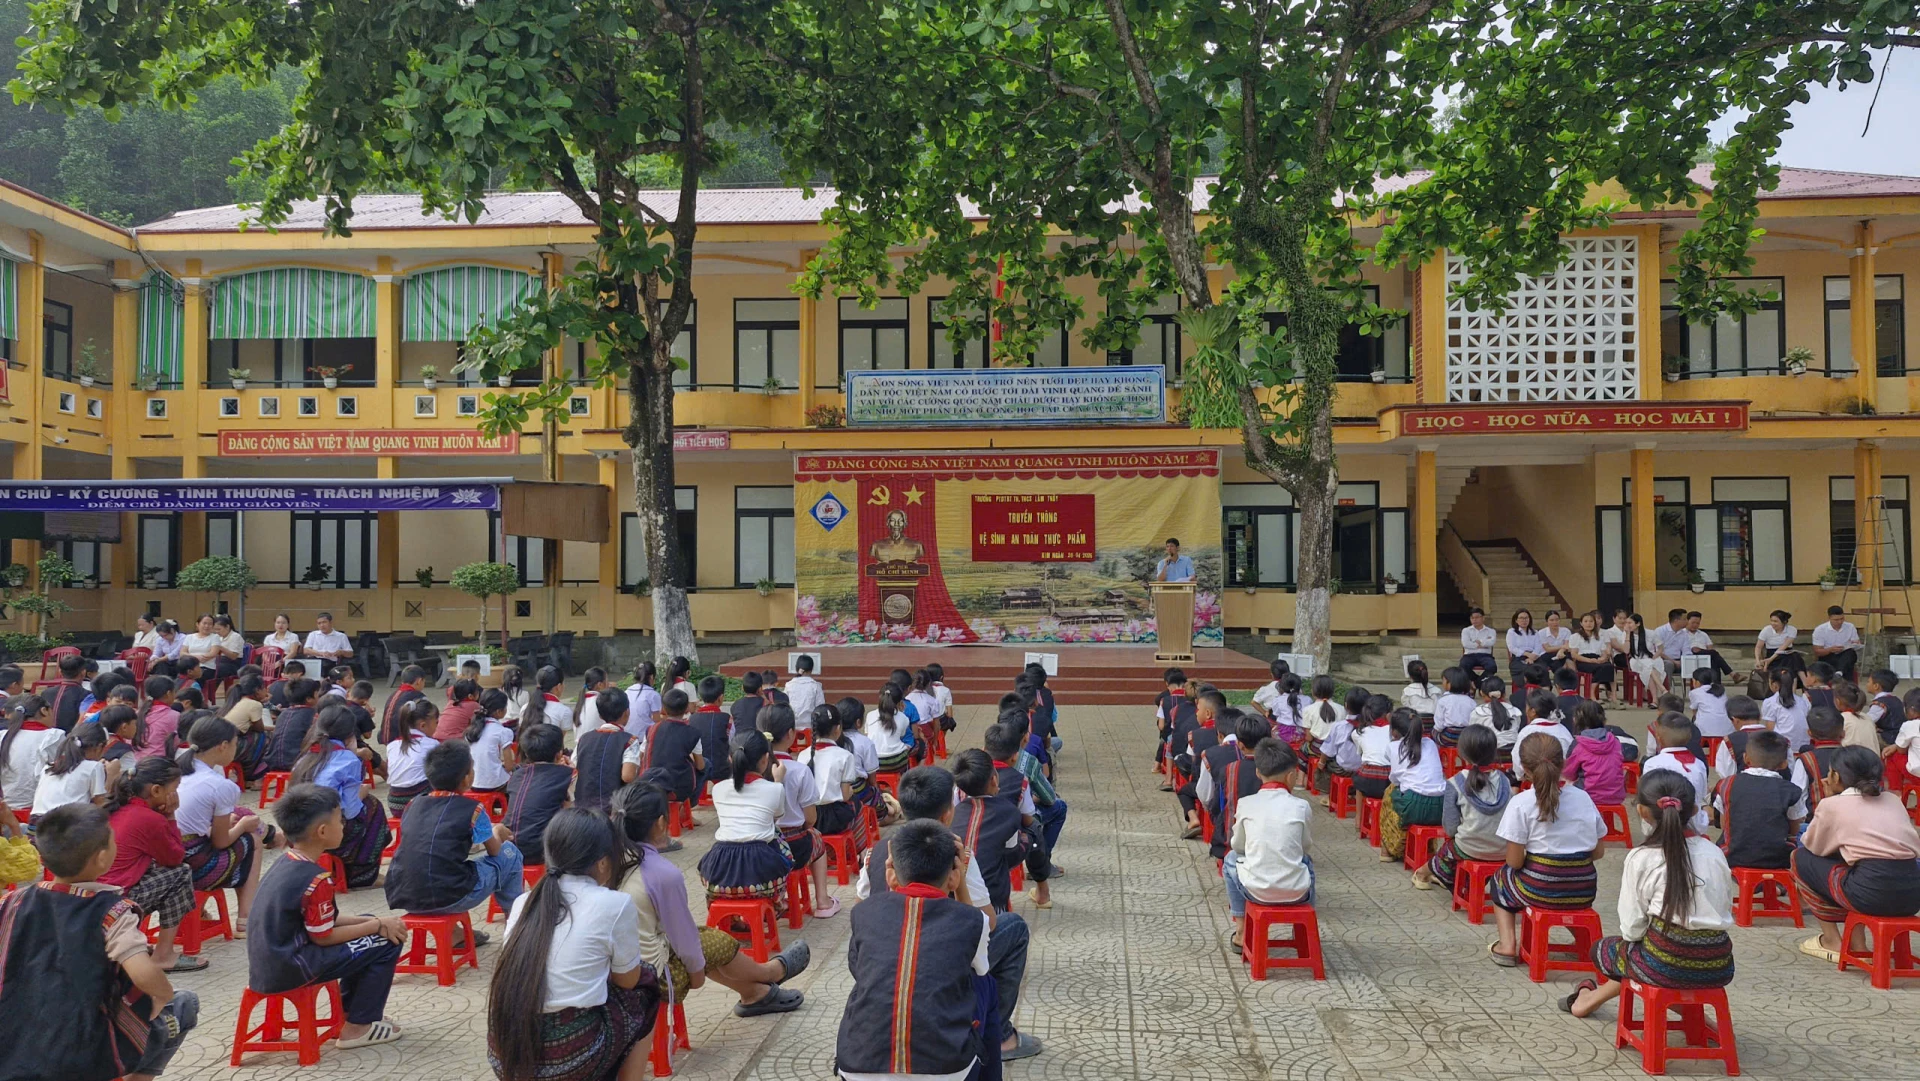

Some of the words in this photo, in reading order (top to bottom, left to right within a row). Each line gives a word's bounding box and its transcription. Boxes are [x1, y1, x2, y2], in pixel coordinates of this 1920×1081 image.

[1416, 416, 1464, 430] HỌC
[1488, 415, 1536, 428] HỌC
[1544, 411, 1592, 425] NỮA
[1614, 413, 1663, 426] HỌC
[1671, 410, 1716, 424] MÃI
[228, 433, 258, 450] ĐẢNG
[261, 435, 290, 452] CỘNG
[293, 432, 314, 449] SẢN
[317, 434, 343, 452] VIỆT
[346, 437, 369, 449] NAM
[372, 437, 410, 452] QUANG
[413, 436, 439, 449] VINH
[443, 434, 473, 449] MUÔN
[689, 435, 706, 447] TIỂU
[709, 437, 725, 448] HỌC
[827, 456, 865, 469] ĐẢNG
[869, 458, 908, 470] CỘNG
[912, 456, 939, 468] SẢN
[943, 457, 976, 469] VIỆT
[980, 458, 1009, 468] NAM
[1015, 458, 1063, 468] QUANG
[1068, 457, 1101, 466] VINH
[1107, 455, 1149, 465] MUÔN
[16, 486, 51, 499] CHỦ
[69, 486, 91, 499] KỶ
[98, 487, 159, 499] CƯƠNG
[177, 486, 218, 499] TÌNH
[223, 487, 295, 499] THƯƠNG
[314, 487, 372, 499] TRÁCH
[379, 486, 440, 500] NHIỆM
[164, 500, 205, 508] DÀNH
[245, 500, 284, 508] GIÁO
[1037, 510, 1057, 523] THÔNG
[979, 532, 987, 546] VỆ
[1011, 534, 1019, 544] AN
[1044, 533, 1061, 546] THỰC
